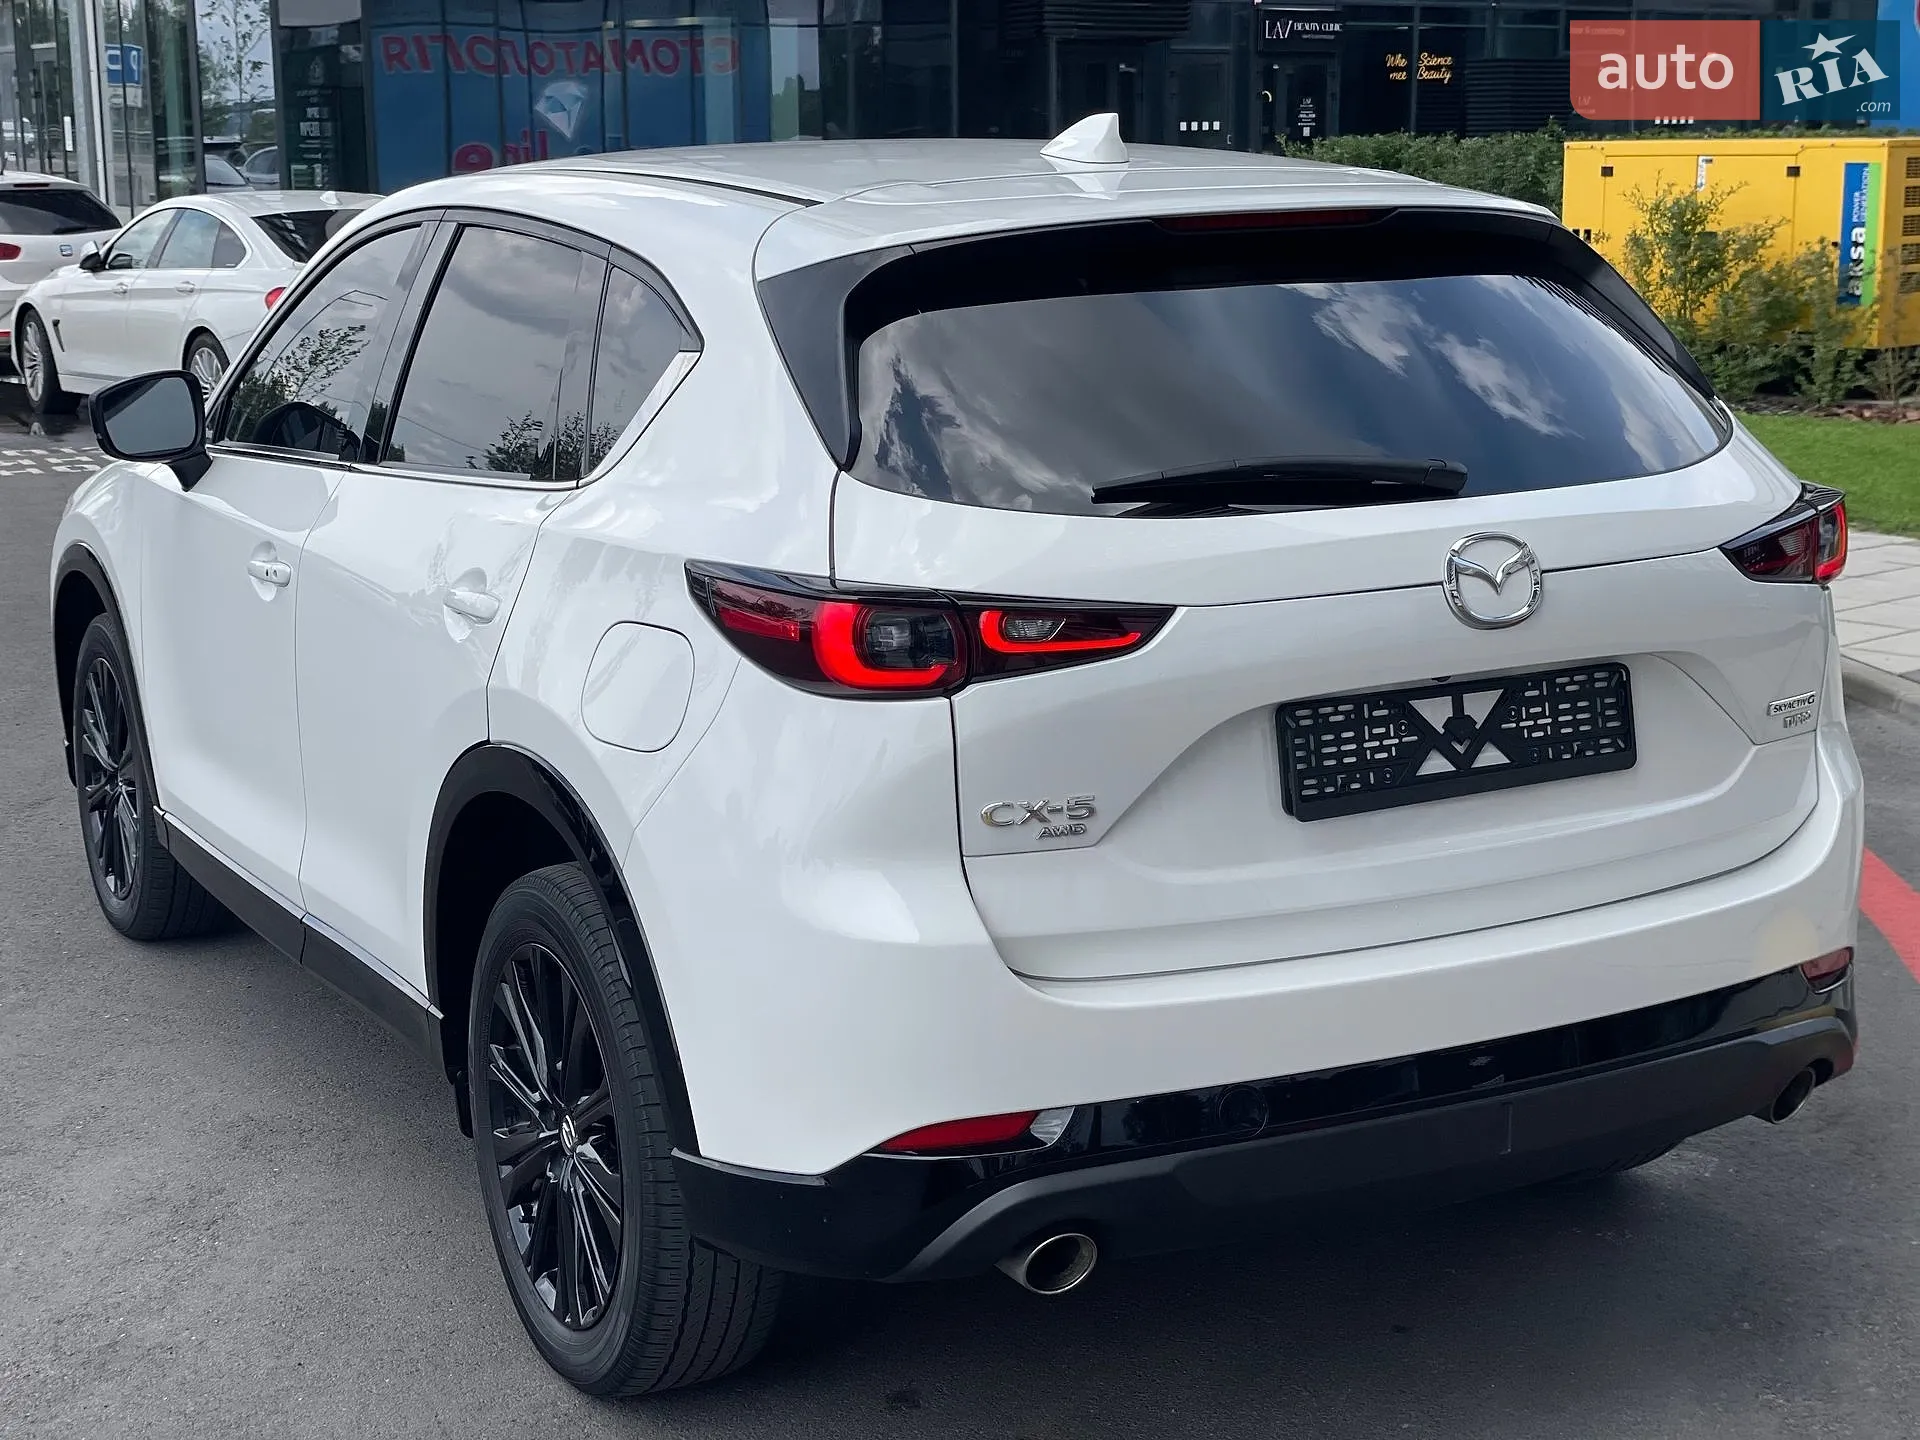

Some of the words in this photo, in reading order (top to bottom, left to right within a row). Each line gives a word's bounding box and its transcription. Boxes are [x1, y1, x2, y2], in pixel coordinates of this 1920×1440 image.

[1418, 52, 1453, 66] Science
[1416, 66, 1452, 84] Beauty
[980, 794, 1097, 827] CX-5
[1034, 823, 1087, 841] AWD
